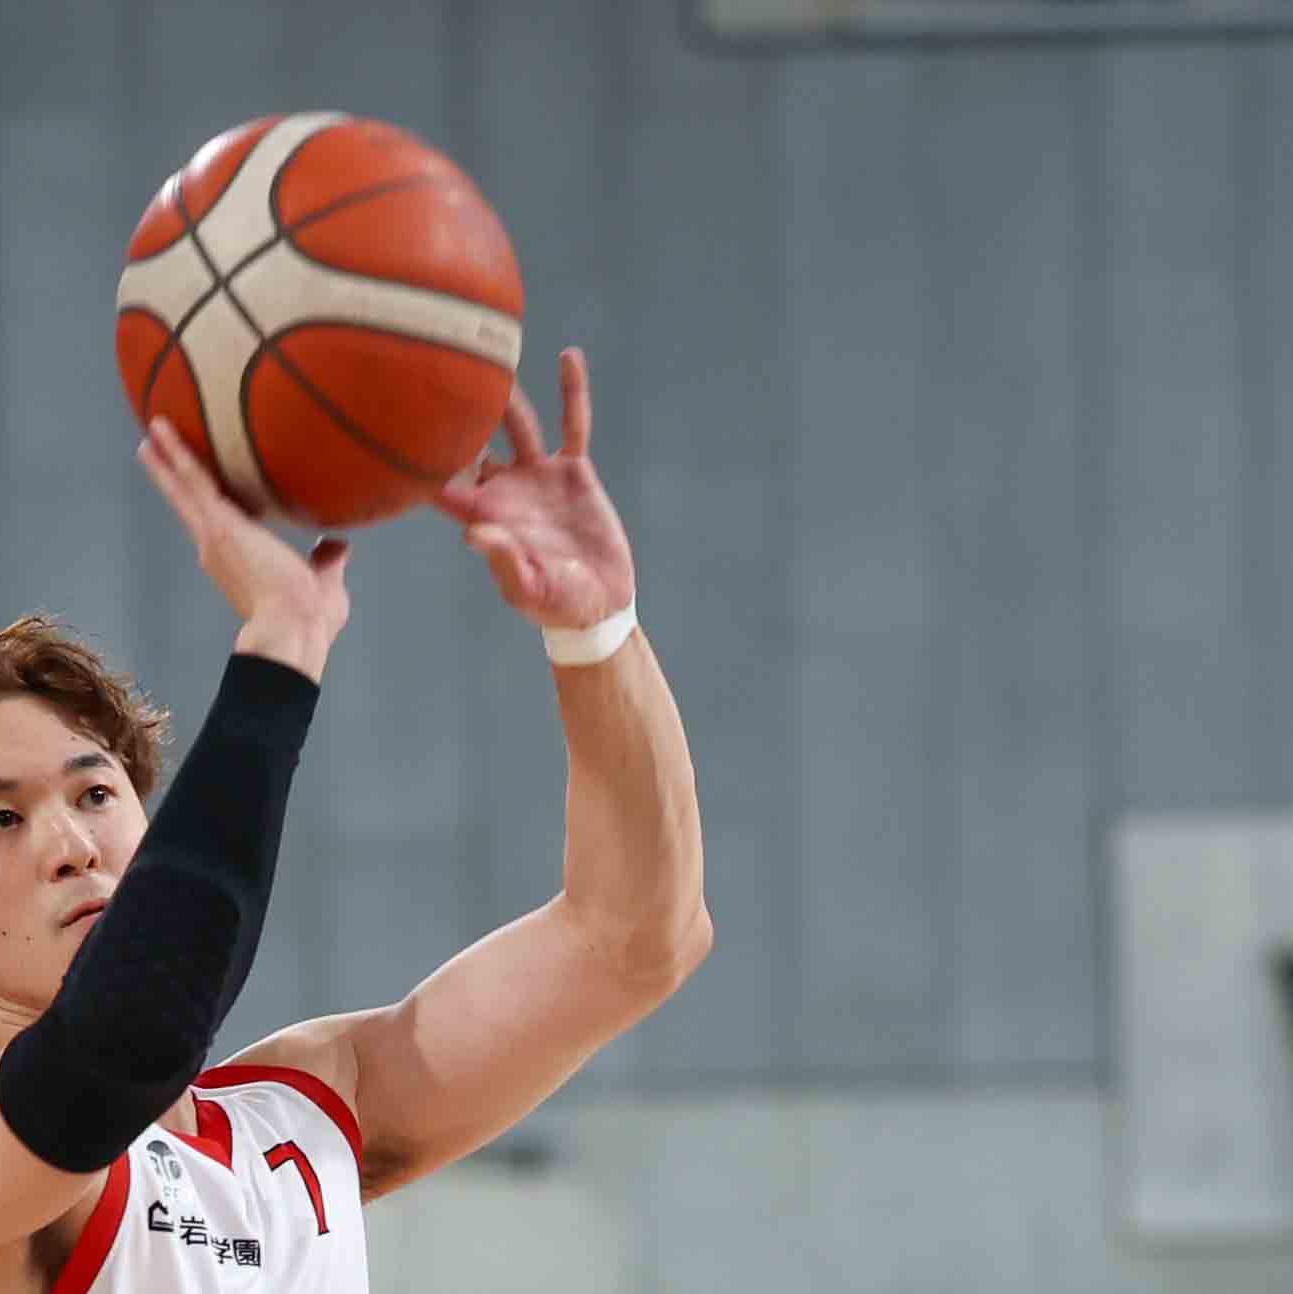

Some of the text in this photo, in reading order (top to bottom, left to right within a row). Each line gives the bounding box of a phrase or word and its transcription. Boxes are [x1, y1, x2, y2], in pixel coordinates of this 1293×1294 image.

[263, 1140, 330, 1235] 7
[179, 1215, 261, 1267] 岩学園
